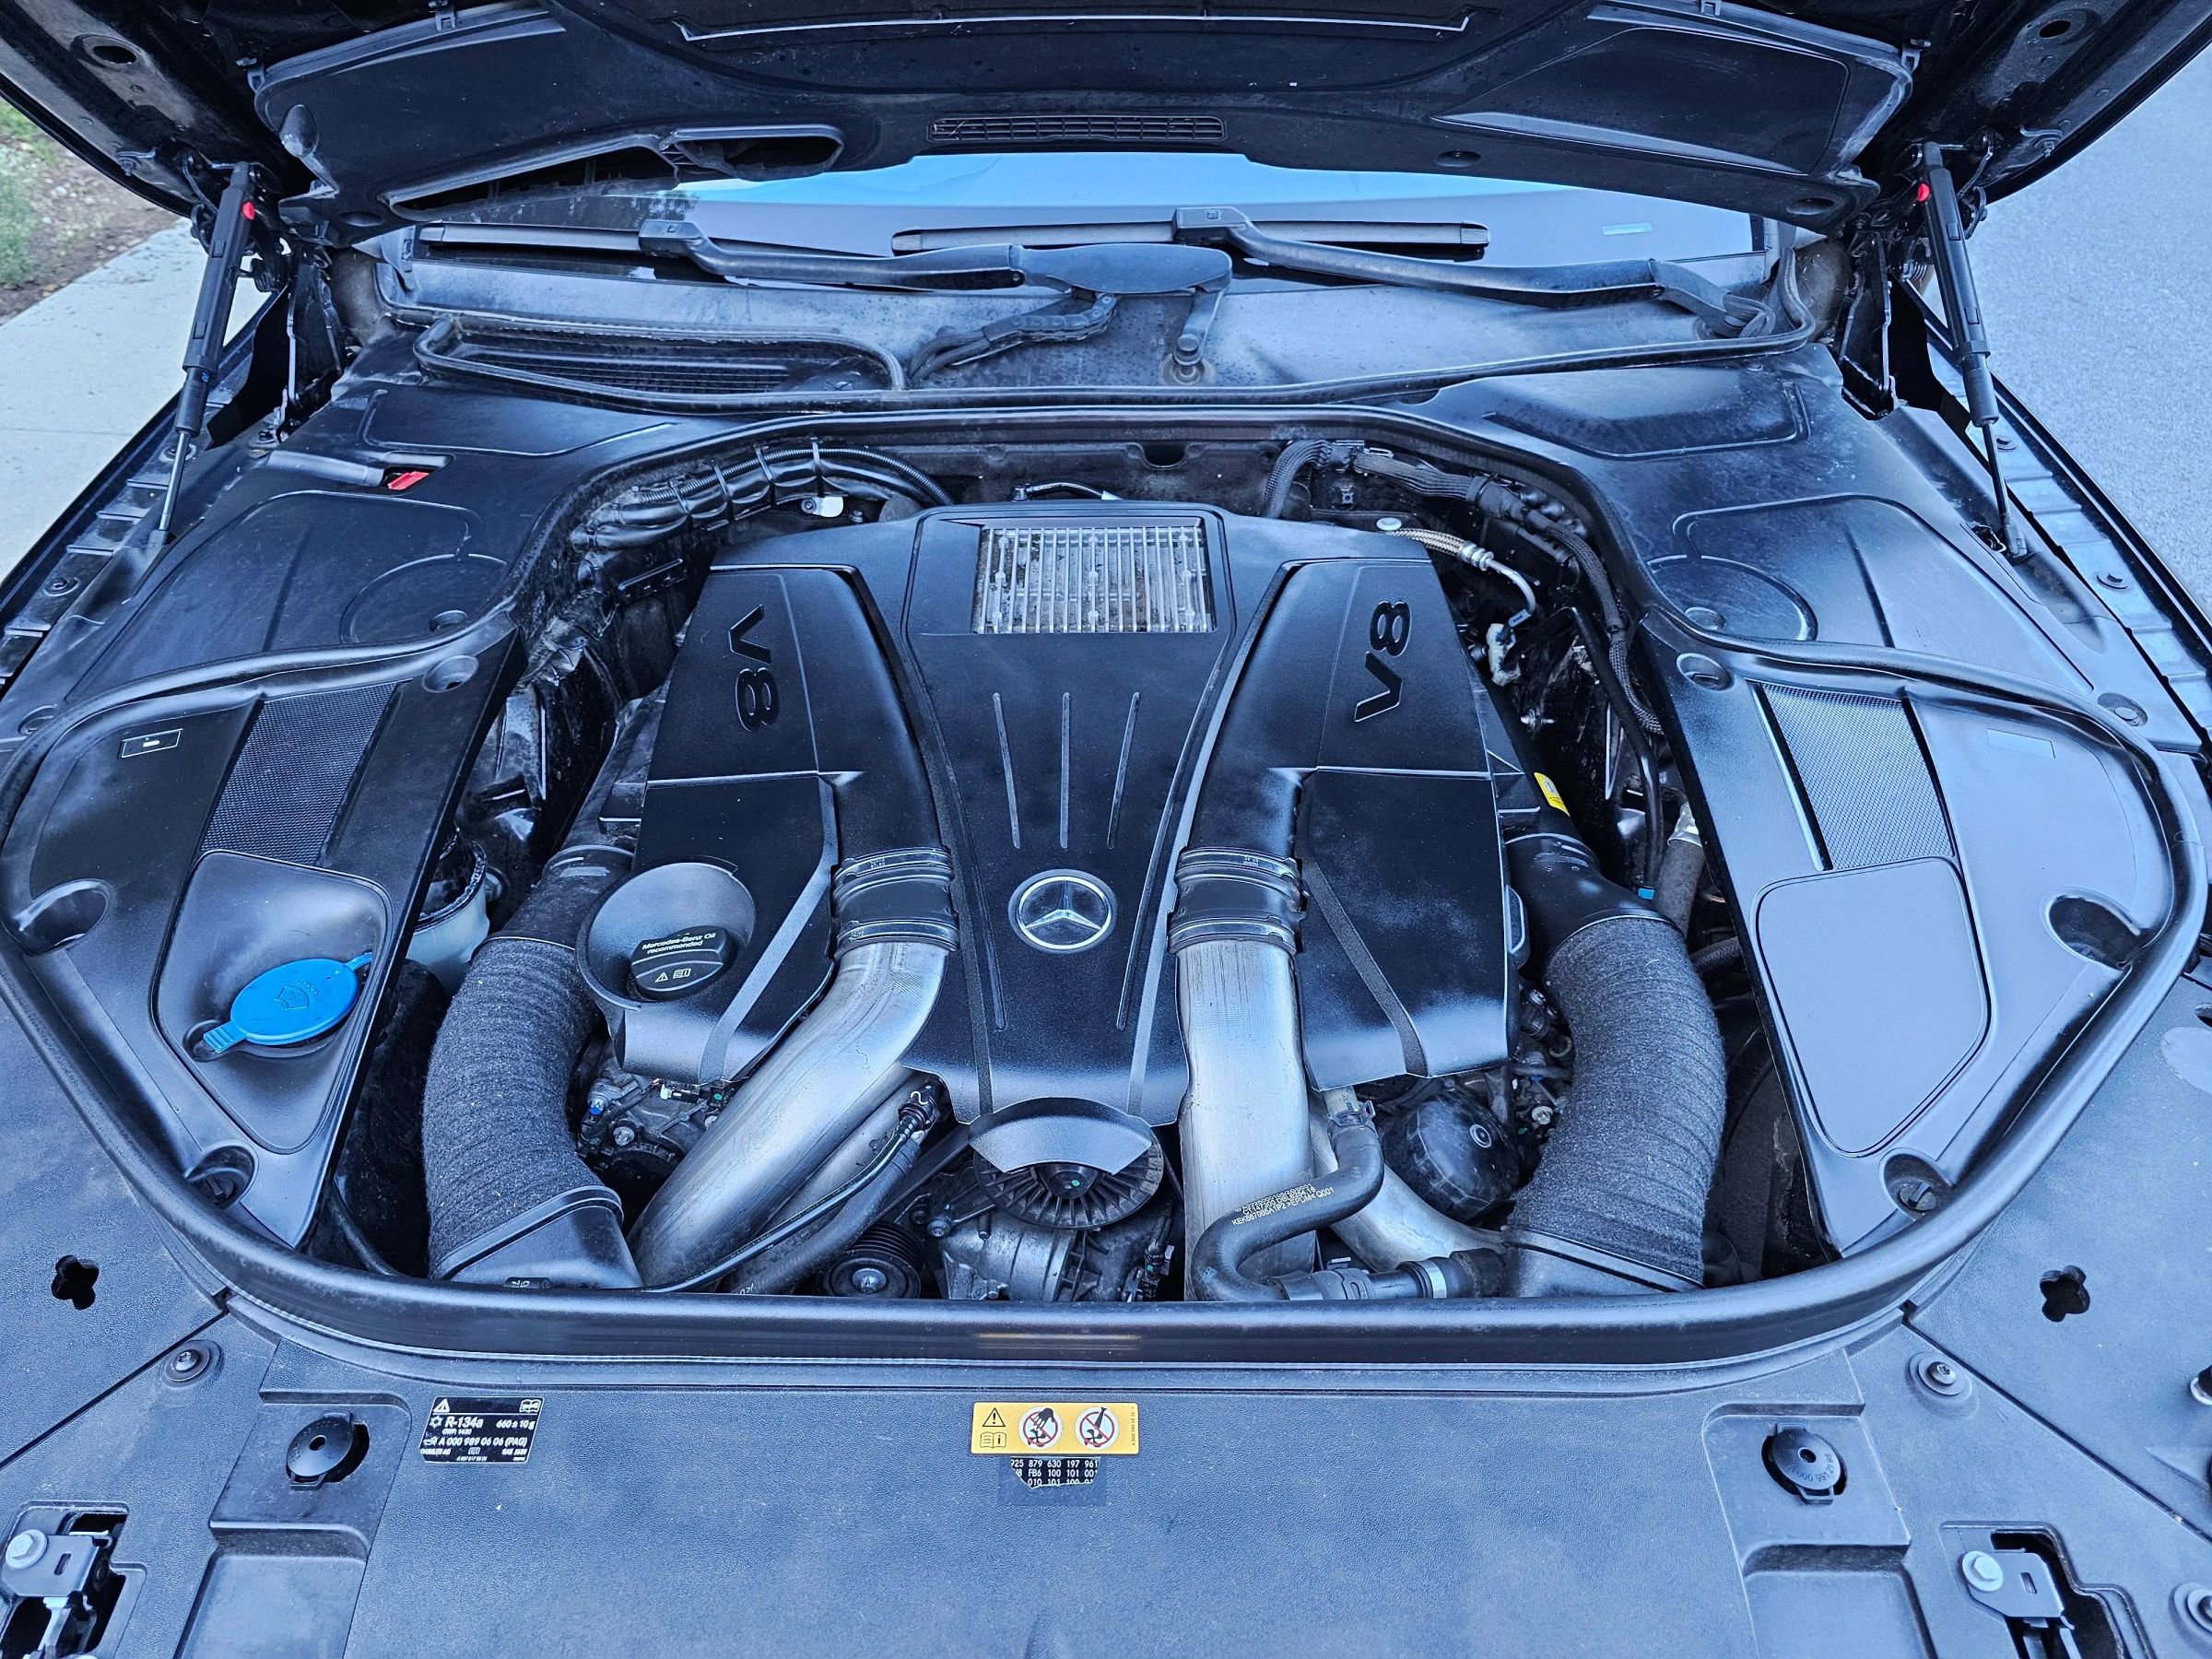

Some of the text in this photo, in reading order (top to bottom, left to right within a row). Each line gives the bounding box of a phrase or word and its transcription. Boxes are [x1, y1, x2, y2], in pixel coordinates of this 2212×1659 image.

[1354, 600, 1411, 722] V8
[727, 604, 781, 733] V8
[641, 935, 702, 950] Mercedes-Benz
[647, 940, 704, 955] recommended
[444, 1416, 484, 1429] R-134a
[438, 1437, 528, 1448] A 000 989 06 06 (PAG)
[1028, 1459, 1042, 1468] 879
[1047, 1459, 1062, 1468] 630
[1066, 1459, 1080, 1468] 197
[1084, 1459, 1098, 1468] 961
[1028, 1468, 1041, 1477] FB6
[1048, 1468, 1061, 1477] 100
[1066, 1468, 1079, 1477] 101
[1796, 1470, 1814, 1482] 000
[1028, 1477, 1042, 1487] 010
